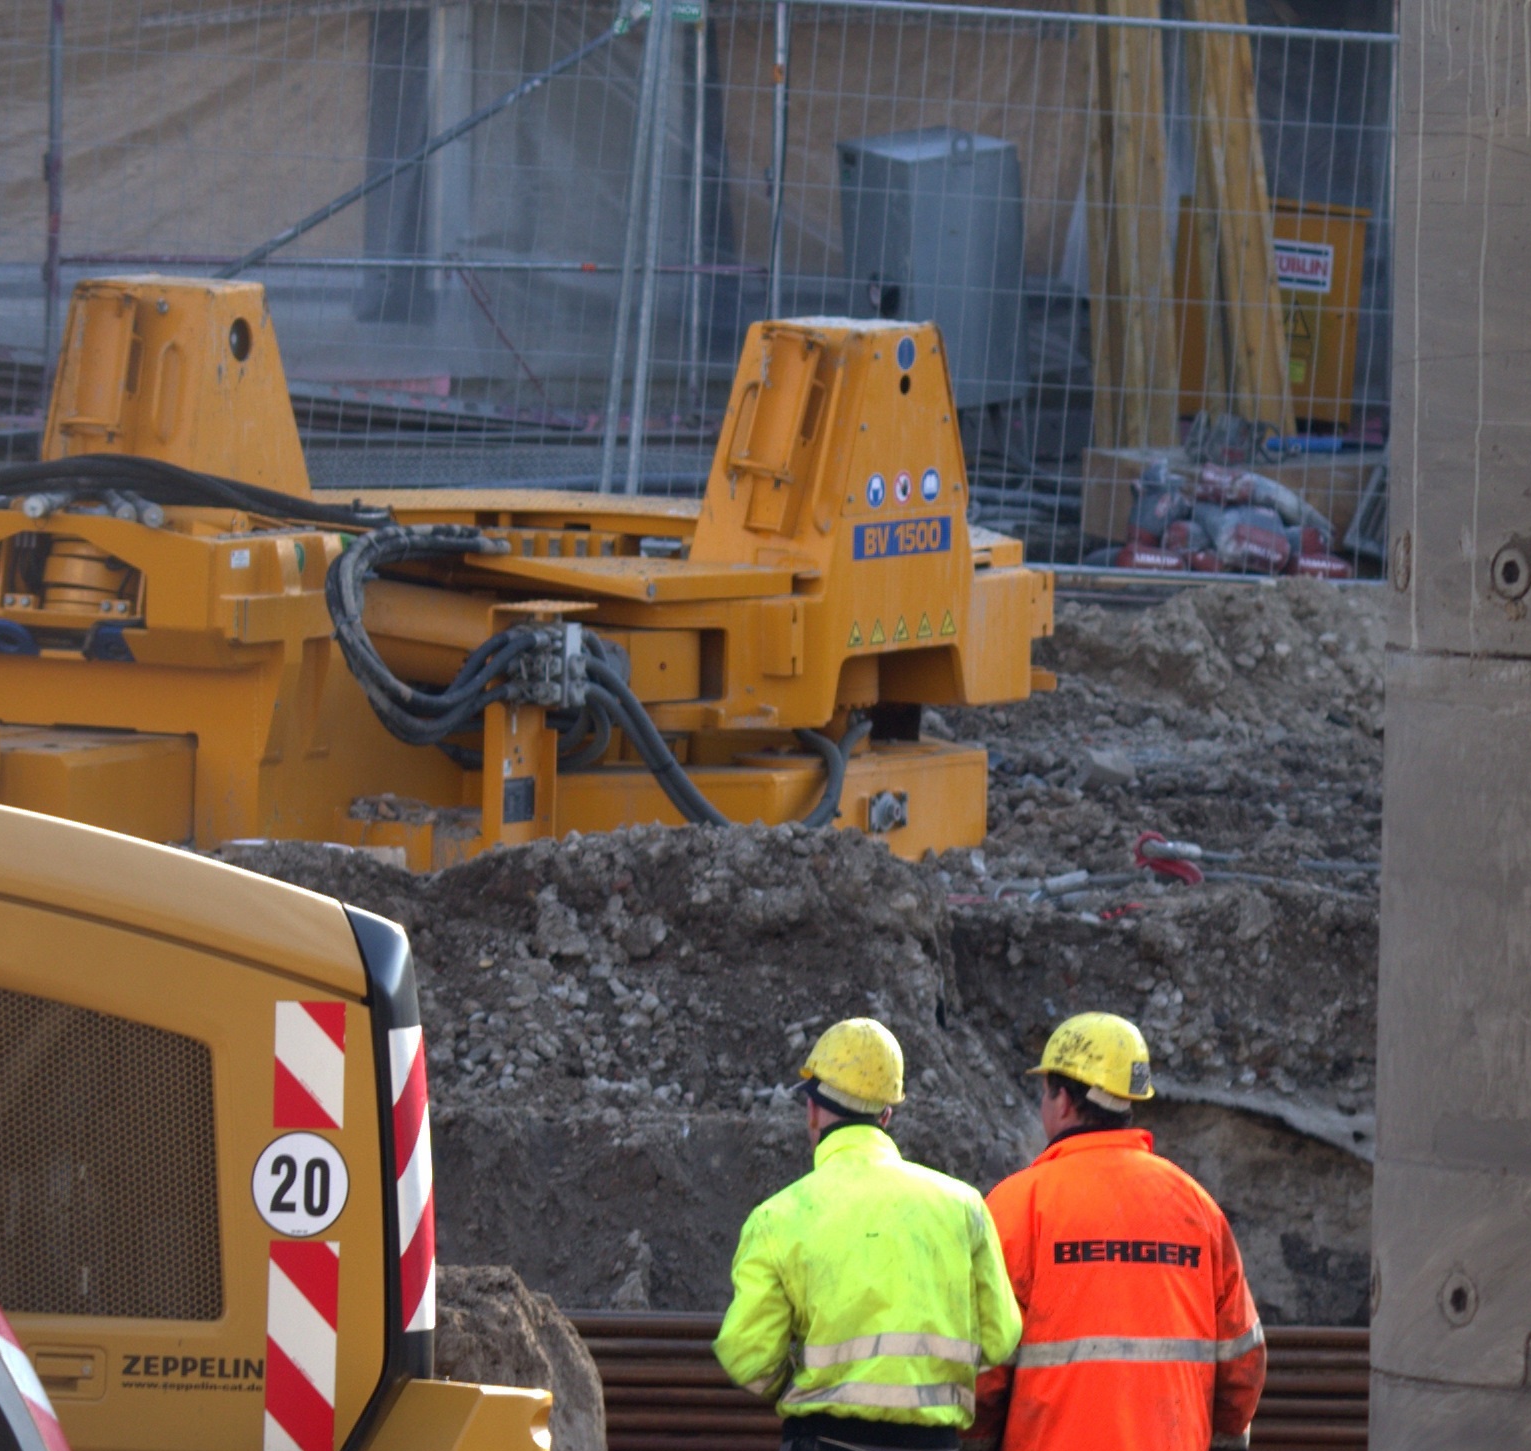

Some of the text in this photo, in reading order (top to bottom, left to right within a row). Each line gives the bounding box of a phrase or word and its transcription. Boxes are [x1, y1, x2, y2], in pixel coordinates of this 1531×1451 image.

[864, 520, 941, 556] BV 1500
[270, 1154, 330, 1217] 20
[1054, 1240, 1201, 1269] BERGER
[122, 1355, 264, 1379] ZEPPELIN
